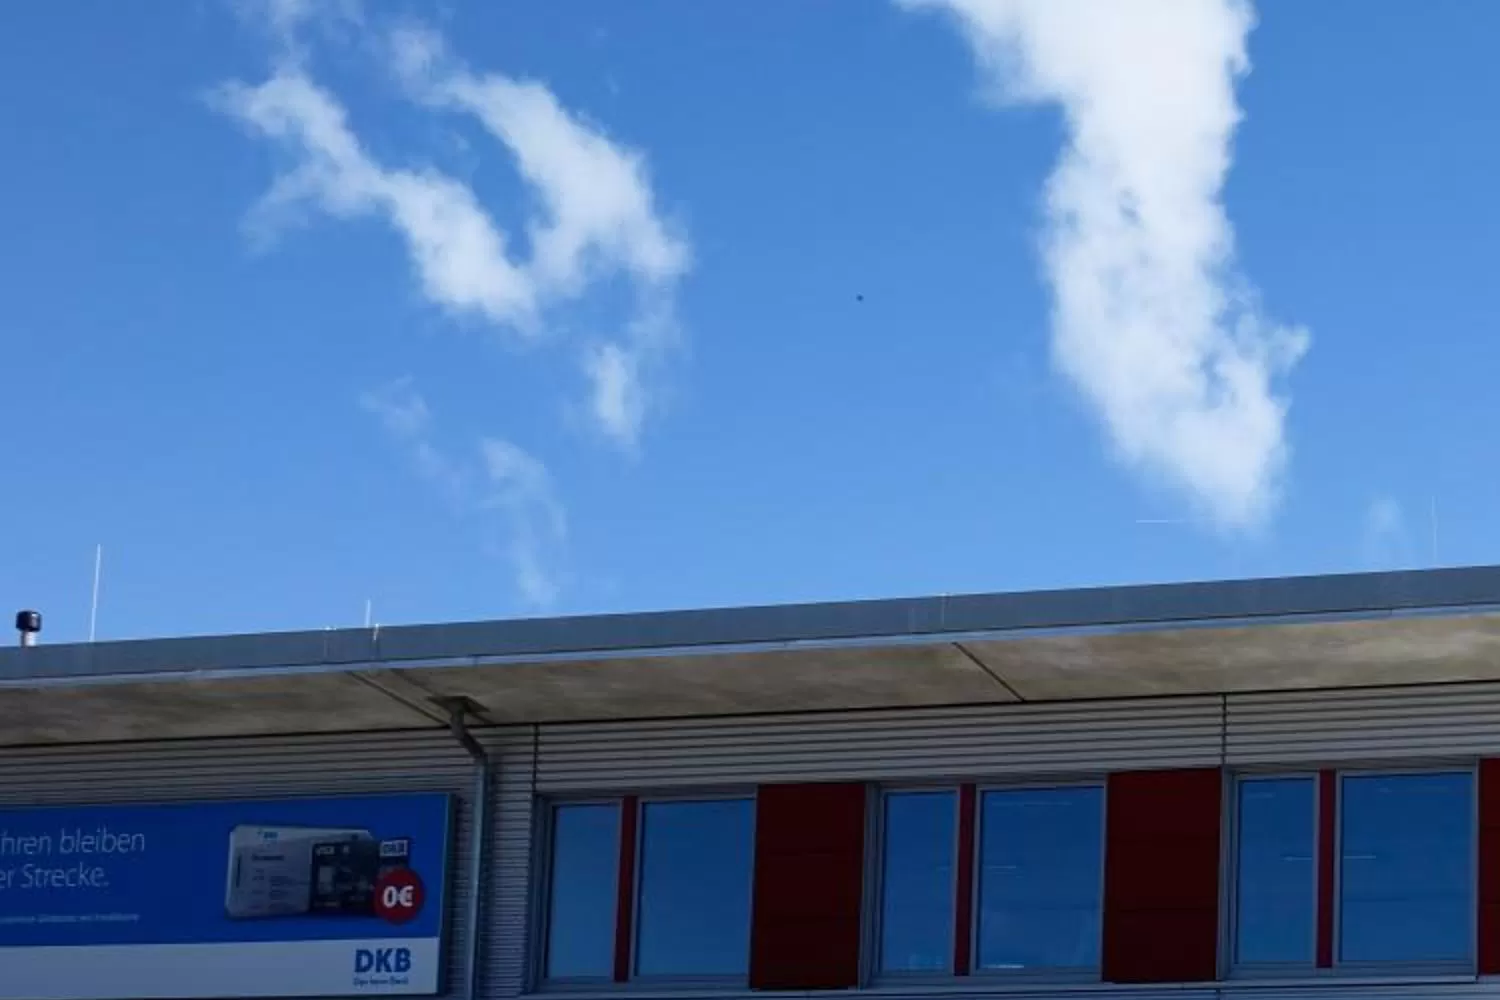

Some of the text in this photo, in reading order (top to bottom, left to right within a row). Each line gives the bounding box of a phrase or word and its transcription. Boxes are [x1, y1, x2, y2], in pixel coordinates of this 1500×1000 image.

[60, 824, 146, 855] bleiben
[20, 861, 110, 889] Strecke.
[382, 885, 414, 908] 0€
[354, 947, 411, 973] DKB
